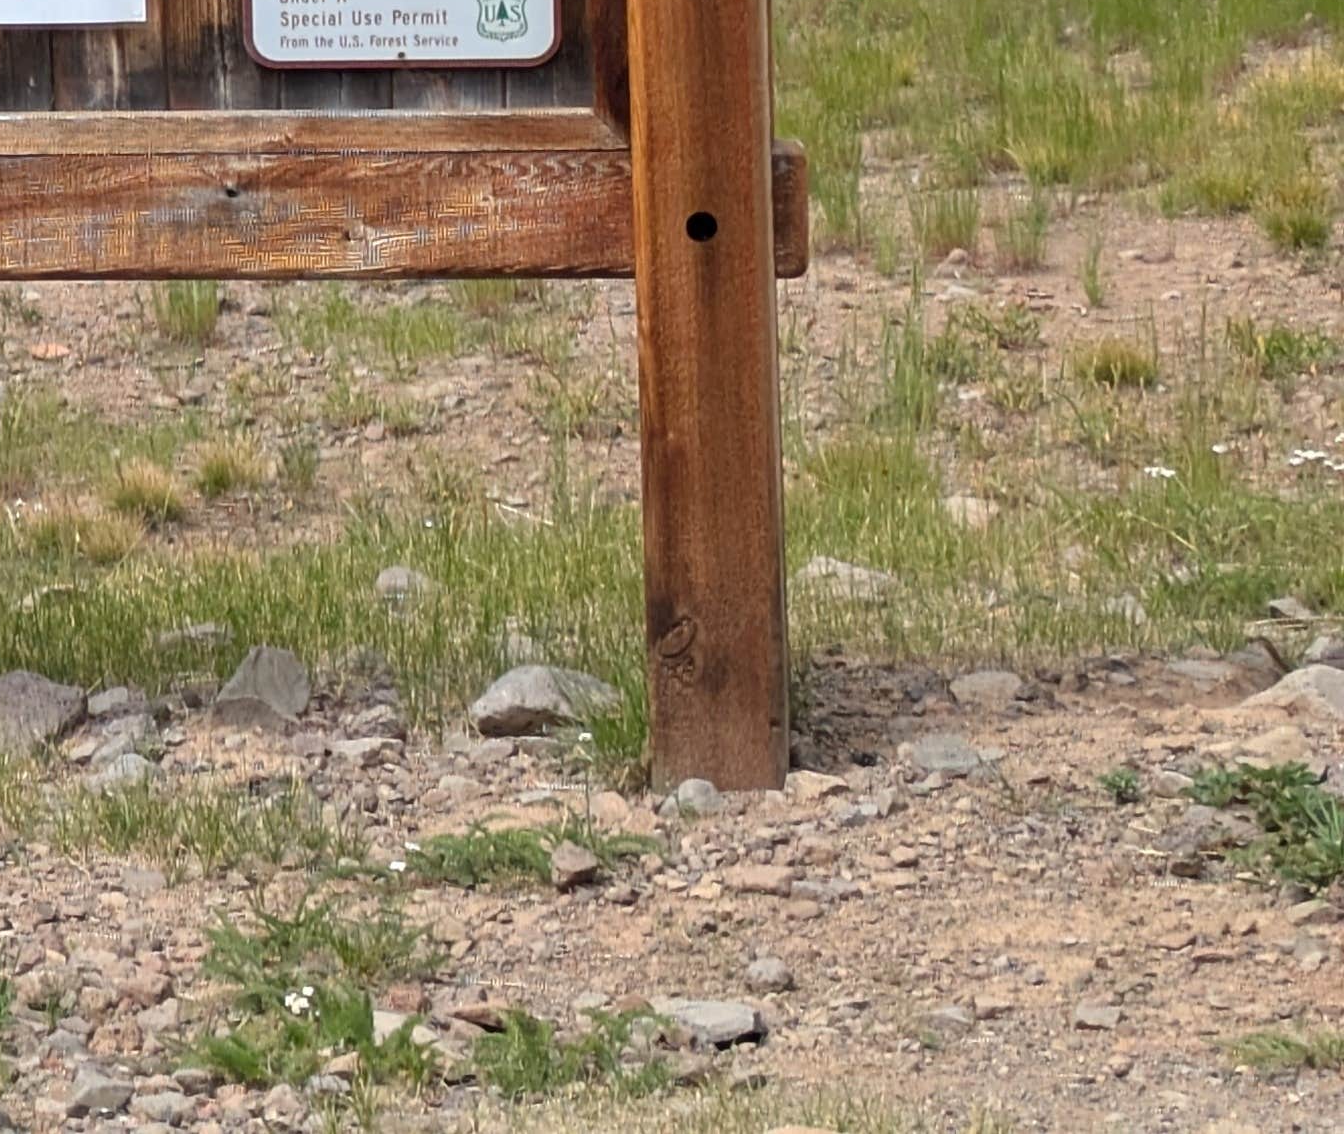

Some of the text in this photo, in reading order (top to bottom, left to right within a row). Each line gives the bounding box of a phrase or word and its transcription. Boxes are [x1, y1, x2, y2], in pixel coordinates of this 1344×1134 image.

[280, 9, 447, 30] Special Use Permit
[280, 33, 458, 49] From the U.S. Forest Service
